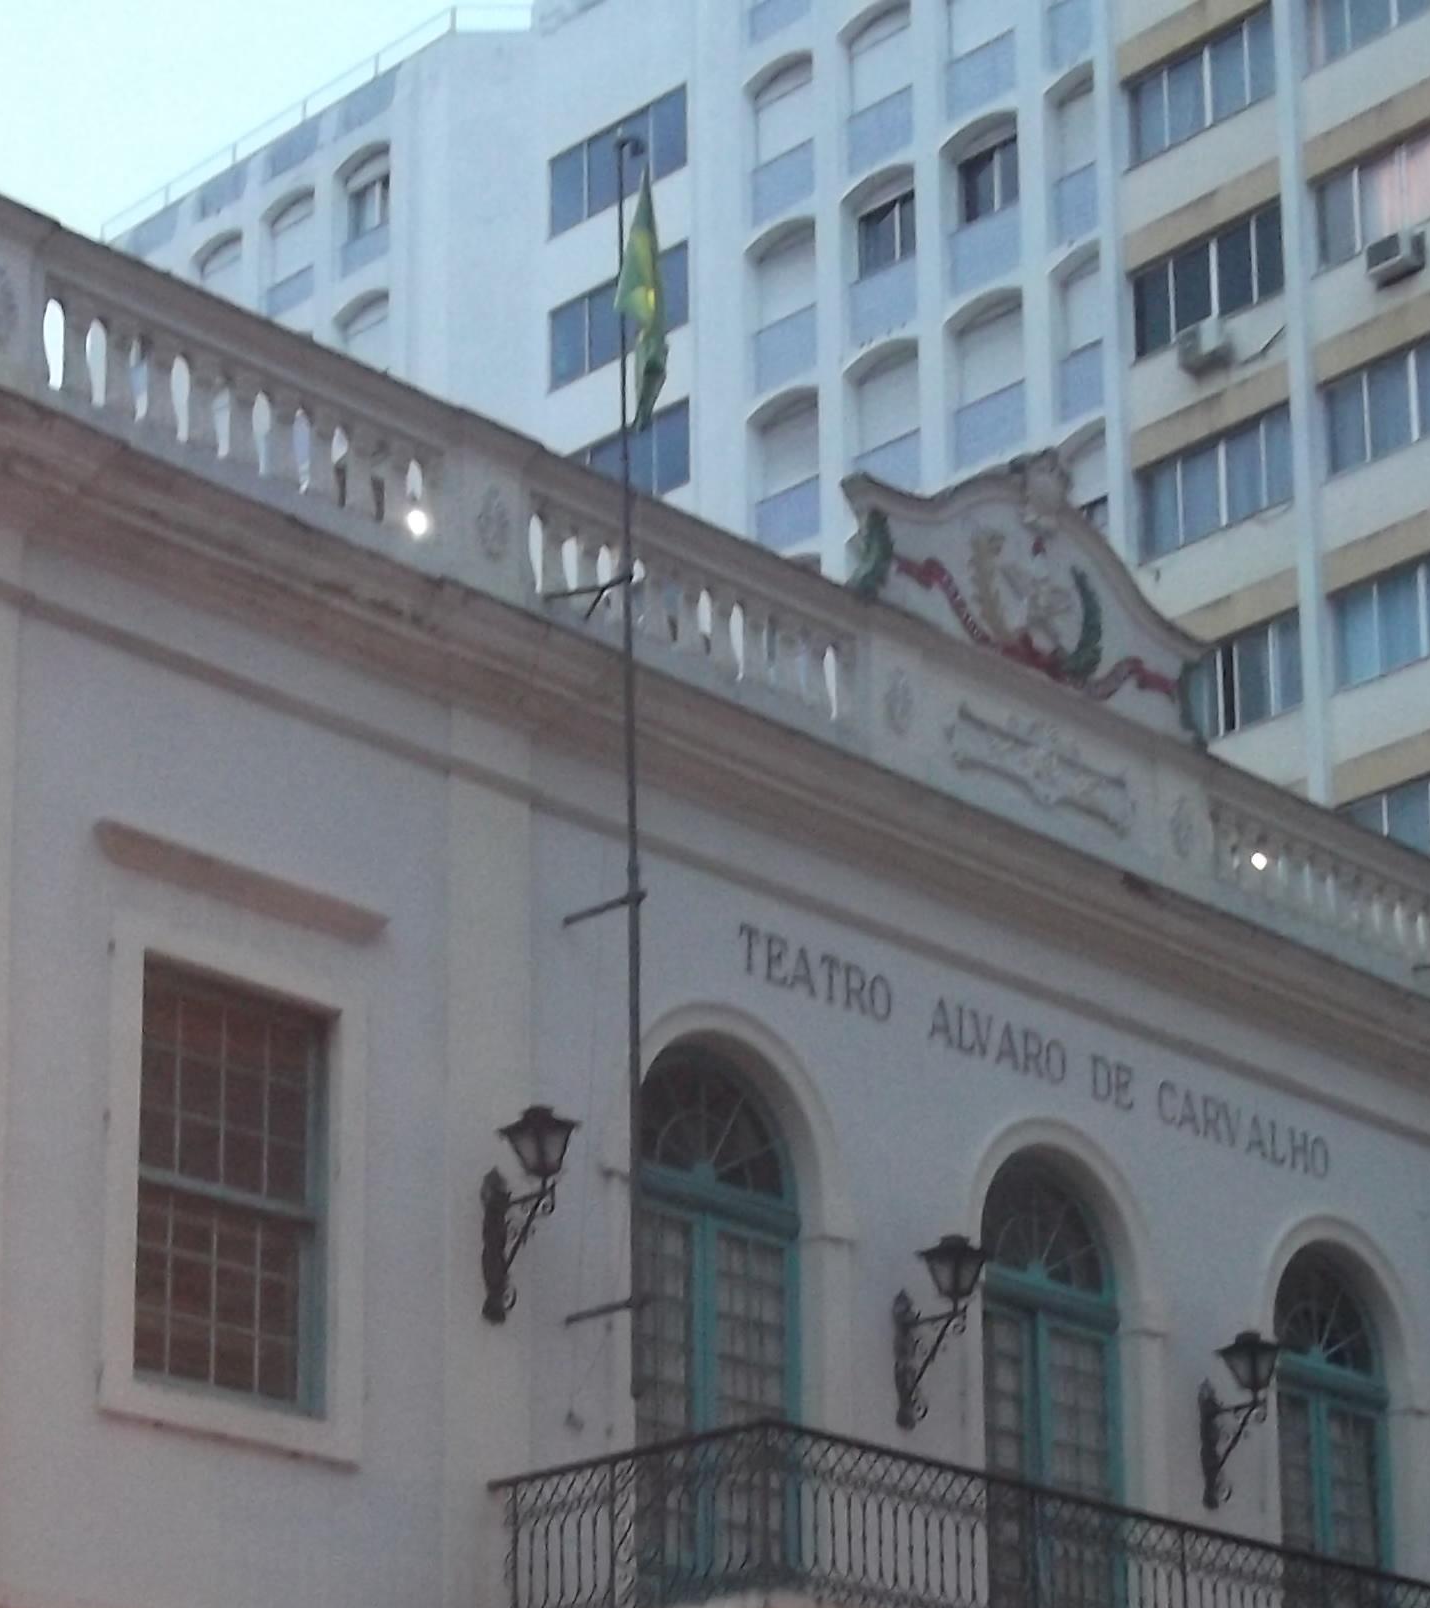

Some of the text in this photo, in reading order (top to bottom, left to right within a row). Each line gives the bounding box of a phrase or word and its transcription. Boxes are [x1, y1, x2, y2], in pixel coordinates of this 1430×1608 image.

[738, 921, 1331, 1180] TEATRO ALVARO DE CARVALHO
